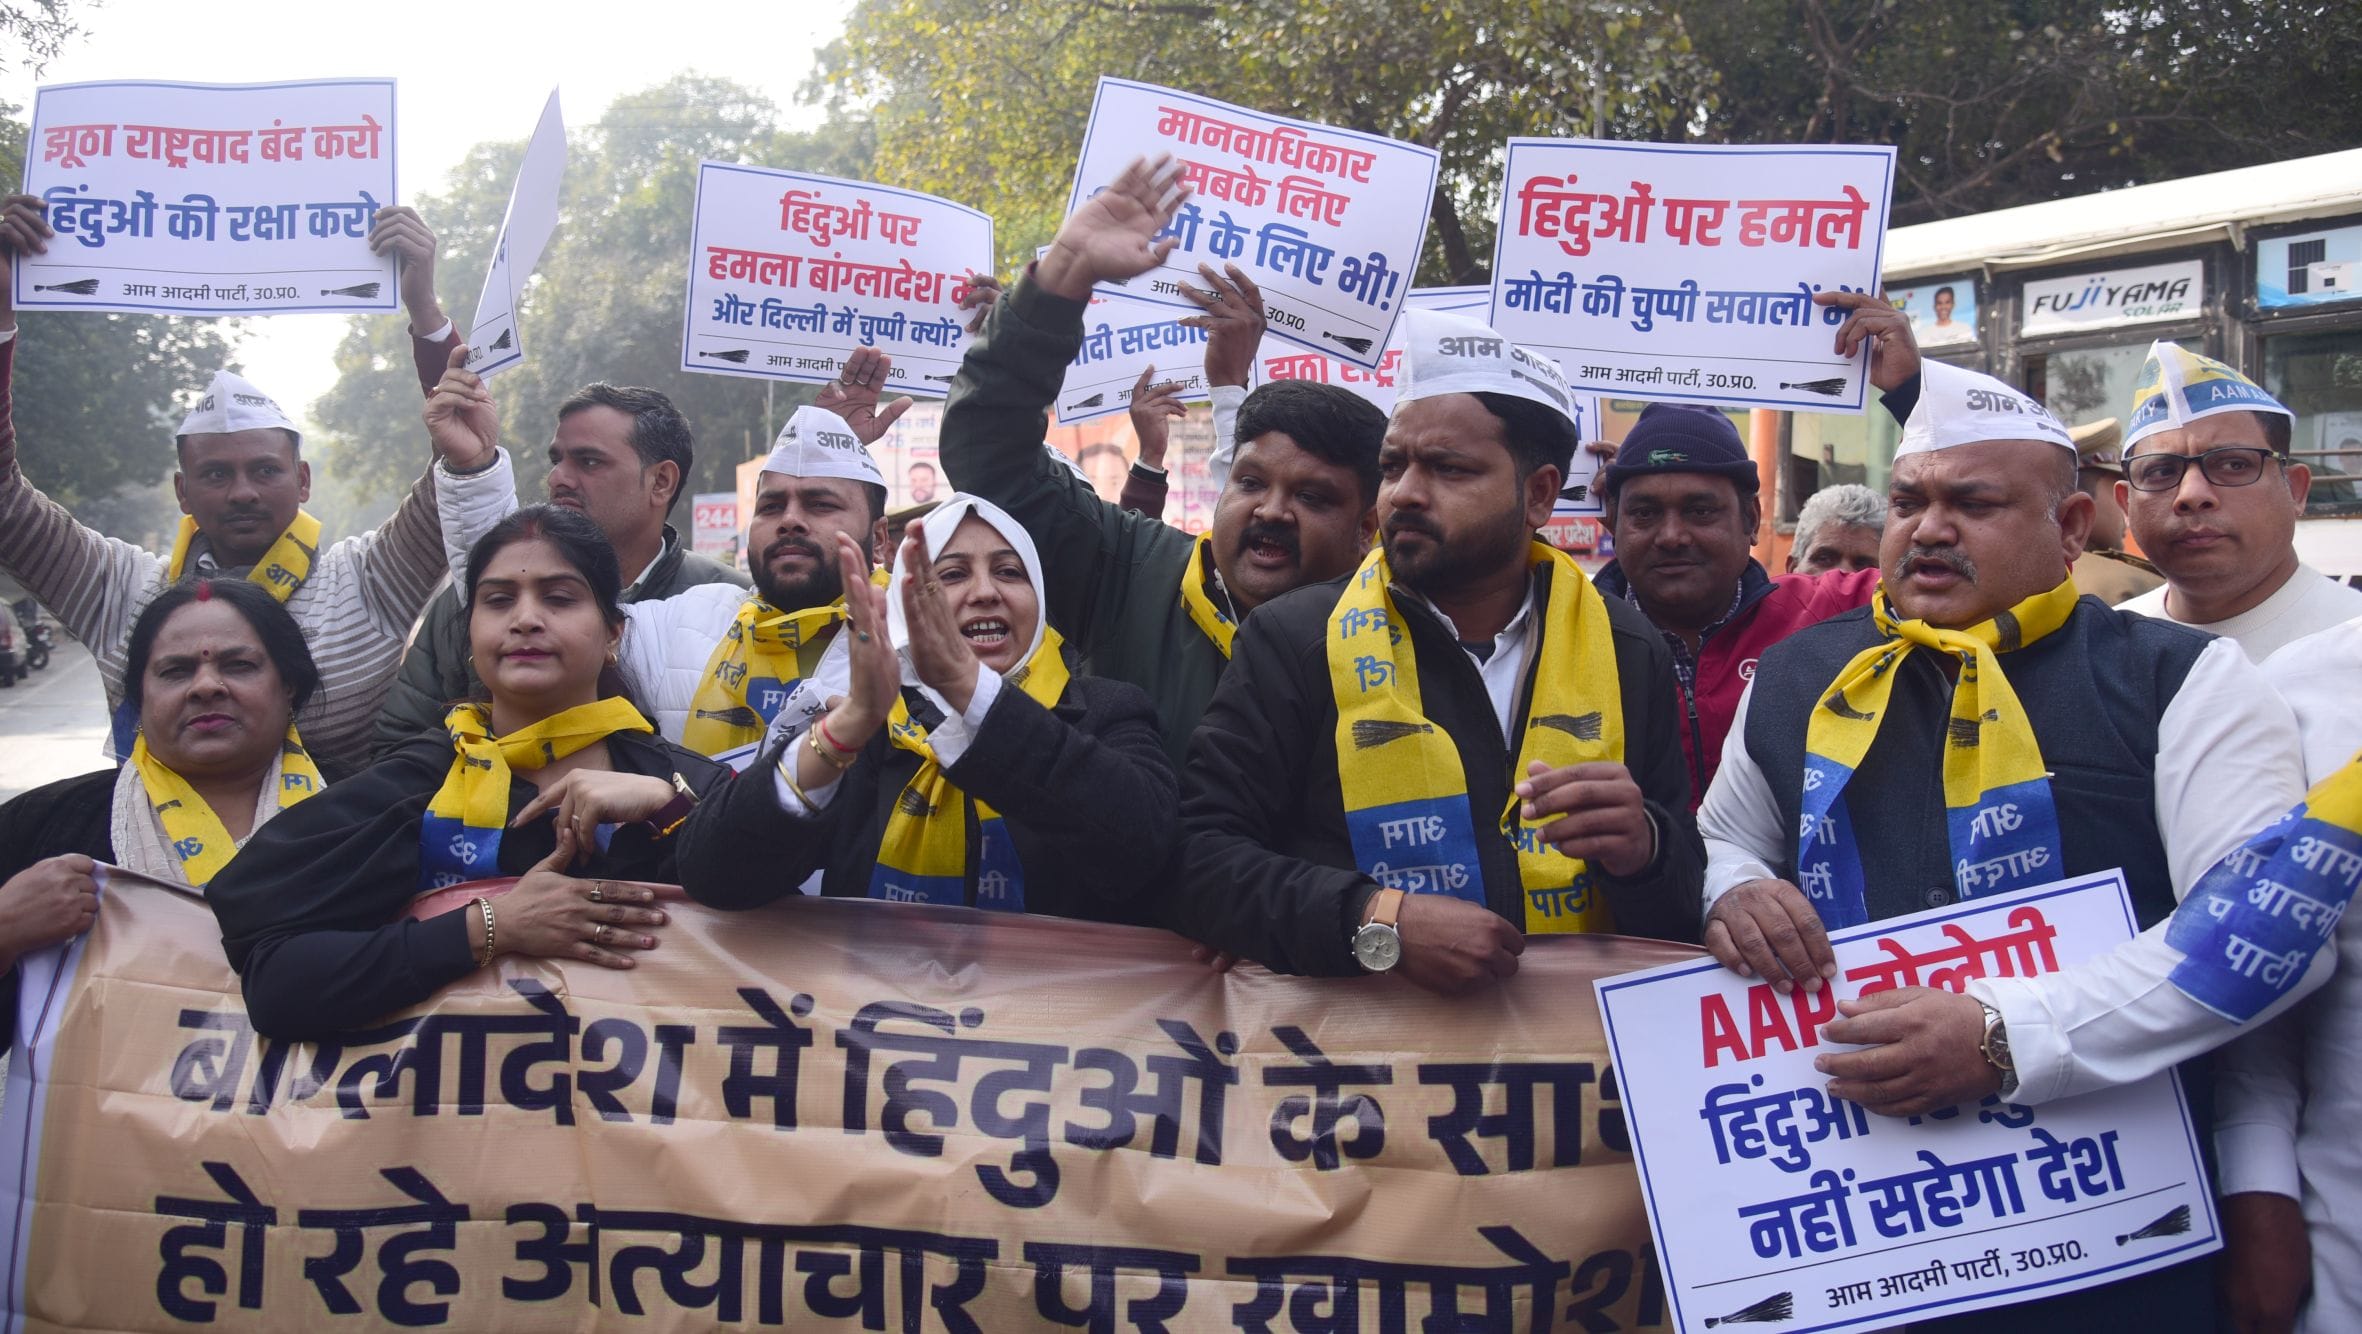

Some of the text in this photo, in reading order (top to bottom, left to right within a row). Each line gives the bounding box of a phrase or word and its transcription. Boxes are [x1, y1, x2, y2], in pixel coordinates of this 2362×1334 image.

[44, 114, 382, 168] झूठा राष्ट्रवाद बंद करो
[1158, 106, 1377, 183] मानवाधिकार
[42, 184, 380, 248] हिंदुओं की रक्षा करो
[780, 190, 922, 247] हिंदुओं पर
[1277, 175, 1351, 227] लिए
[1518, 174, 1870, 257] हिंदुओं पर हमले
[707, 246, 803, 288] हमला
[808, 252, 945, 304] बांग्लादेश
[1209, 211, 1250, 259] के
[1256, 223, 1335, 284] लिए
[1338, 252, 1400, 311] भी!
[123, 283, 157, 298] आम
[161, 283, 211, 301] आदमी
[214, 284, 250, 302] पार्टी,
[712, 293, 963, 348] और दिल्ली में चुप्पी क्यों?
[1505, 270, 1577, 314] मोदी
[1582, 275, 1625, 318] की
[1632, 280, 1700, 332] चुप्पी
[1706, 282, 1821, 327] सवालों
[2123, 302, 2183, 317] SOLAR
[766, 355, 792, 367] आम
[795, 357, 834, 371] आदमी
[1439, 336, 1504, 358] आम
[1580, 364, 1611, 380] आम
[1615, 366, 1662, 385] आदमी
[1667, 368, 1702, 387] पार्टी,
[1967, 389, 2023, 414] आम
[2211, 386, 2249, 401] AAM
[817, 431, 855, 452] आम
[697, 508, 737, 528] 244
[2247, 878, 2347, 938] आदमी
[2225, 934, 2306, 990] पार्टी
[1700, 978, 1837, 1069] AAP
[717, 987, 815, 1132] में
[836, 999, 1240, 1209] हिंदुओं
[1263, 1026, 1393, 1171] के
[1738, 1127, 2126, 1260] नहीं सहेगा देश
[155, 1161, 277, 1323] हो
[299, 1165, 470, 1327] रहे
[503, 1203, 999, 1334] अत्याचार
[1025, 1240, 1200, 1334] पर
[1825, 1280, 1874, 1309] आम
[1877, 1259, 1948, 1298] आदमी
[1951, 1248, 2010, 1278] पार्टी,
